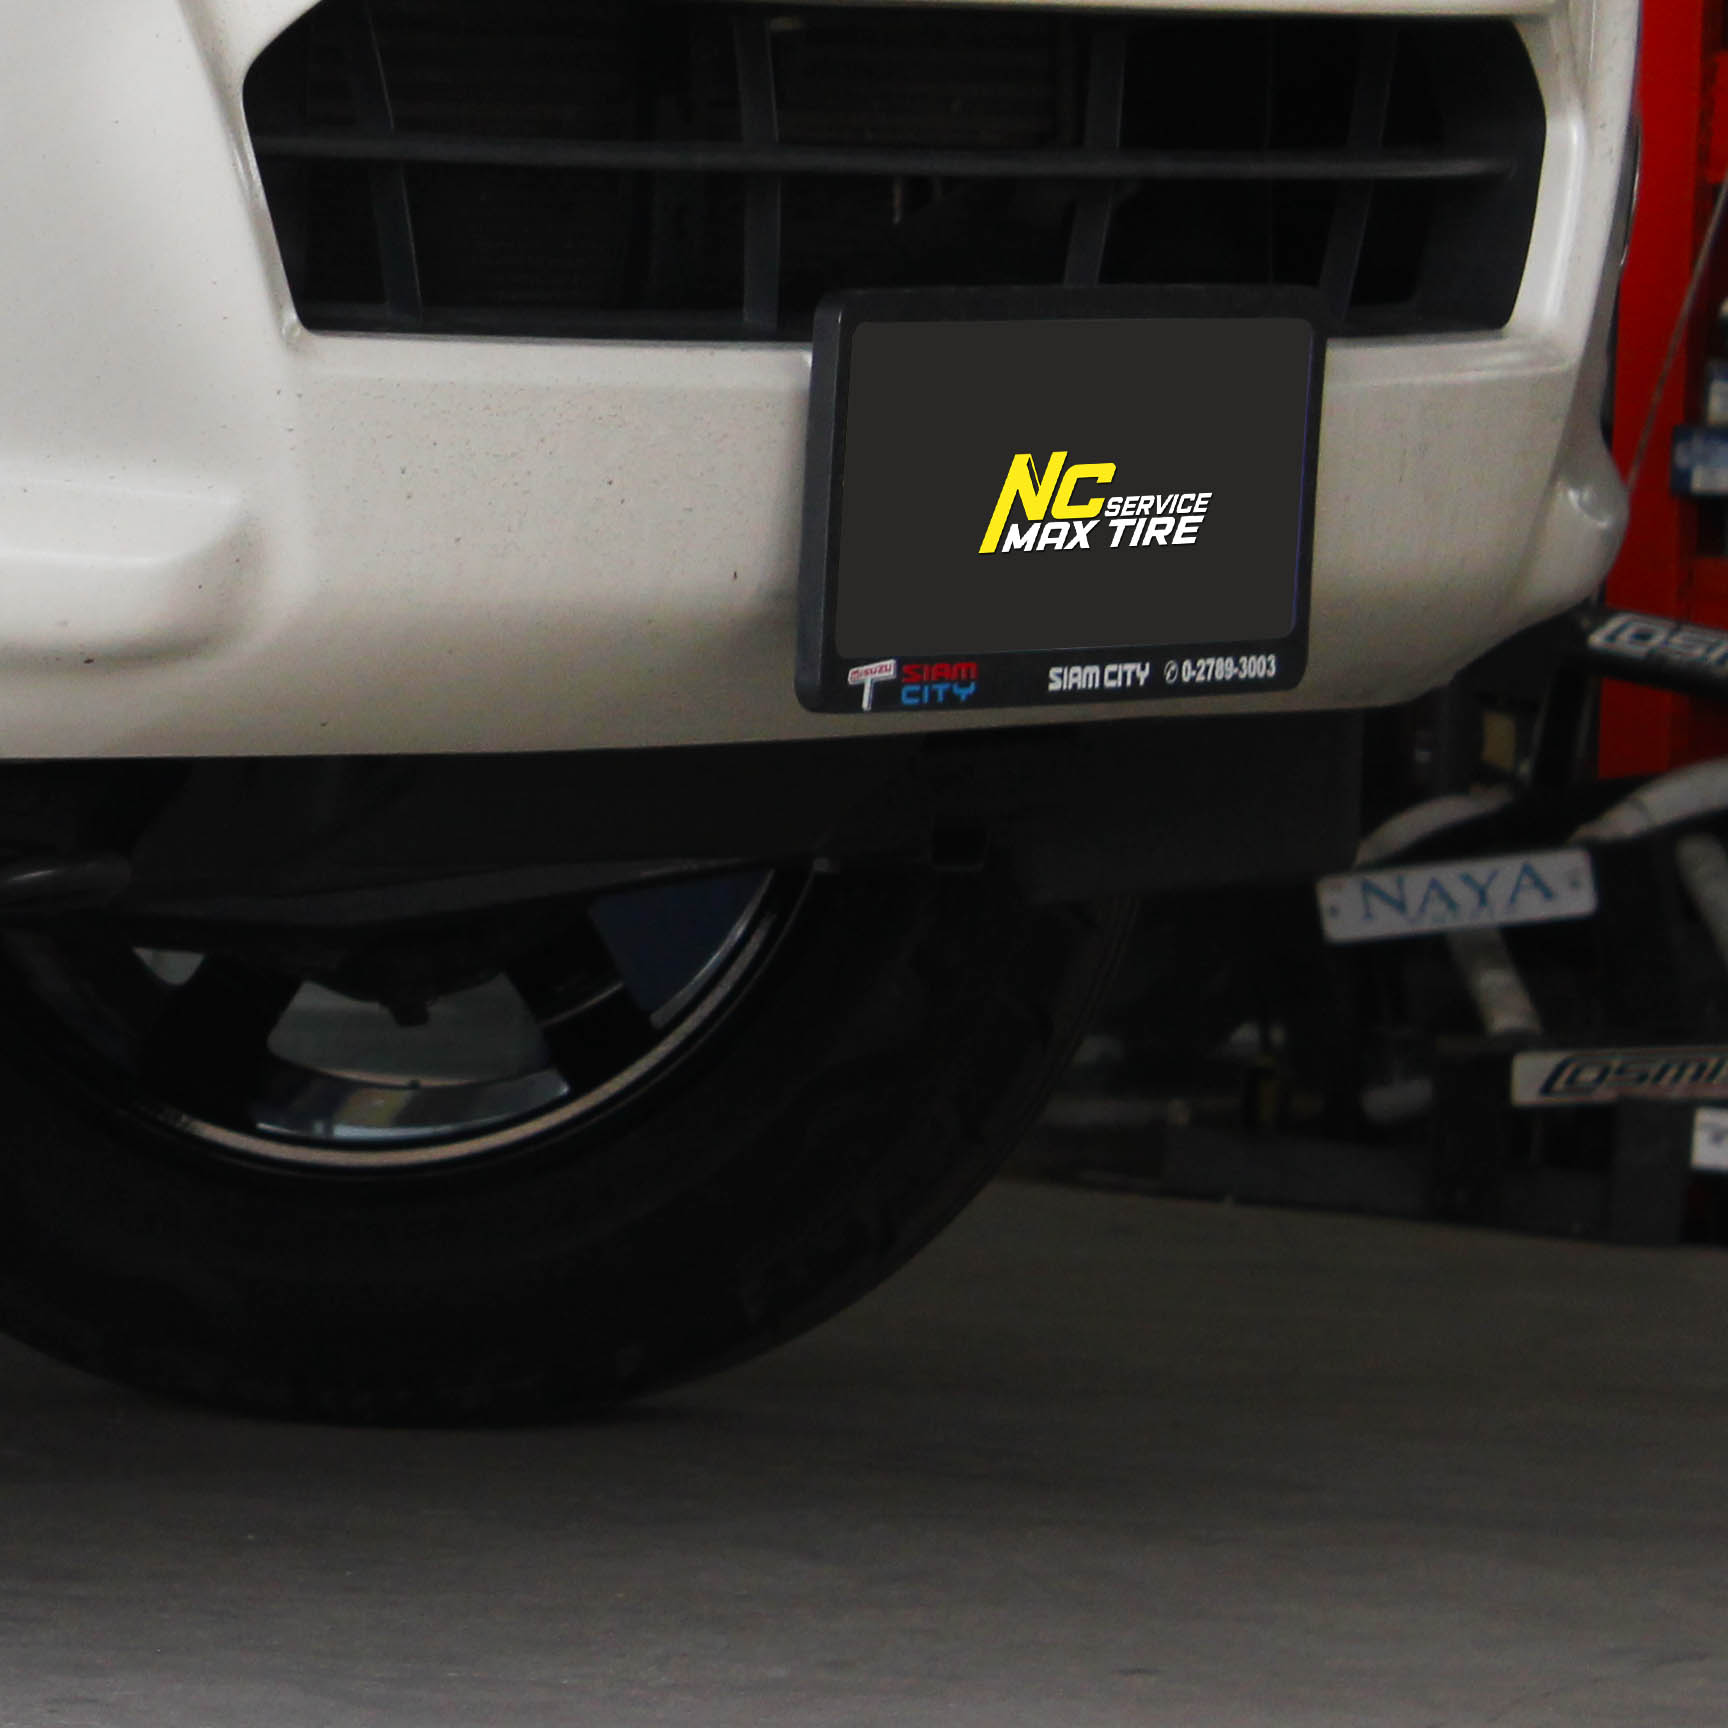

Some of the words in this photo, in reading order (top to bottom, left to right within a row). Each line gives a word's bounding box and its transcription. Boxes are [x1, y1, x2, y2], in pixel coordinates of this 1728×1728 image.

[902, 661, 978, 683] SIAM
[1049, 666, 1101, 691] SIAM
[1104, 662, 1151, 688] CITY
[1182, 654, 1277, 684] 0-2789-3003
[901, 682, 976, 706] CITY
[1360, 861, 1555, 920] NAYA
